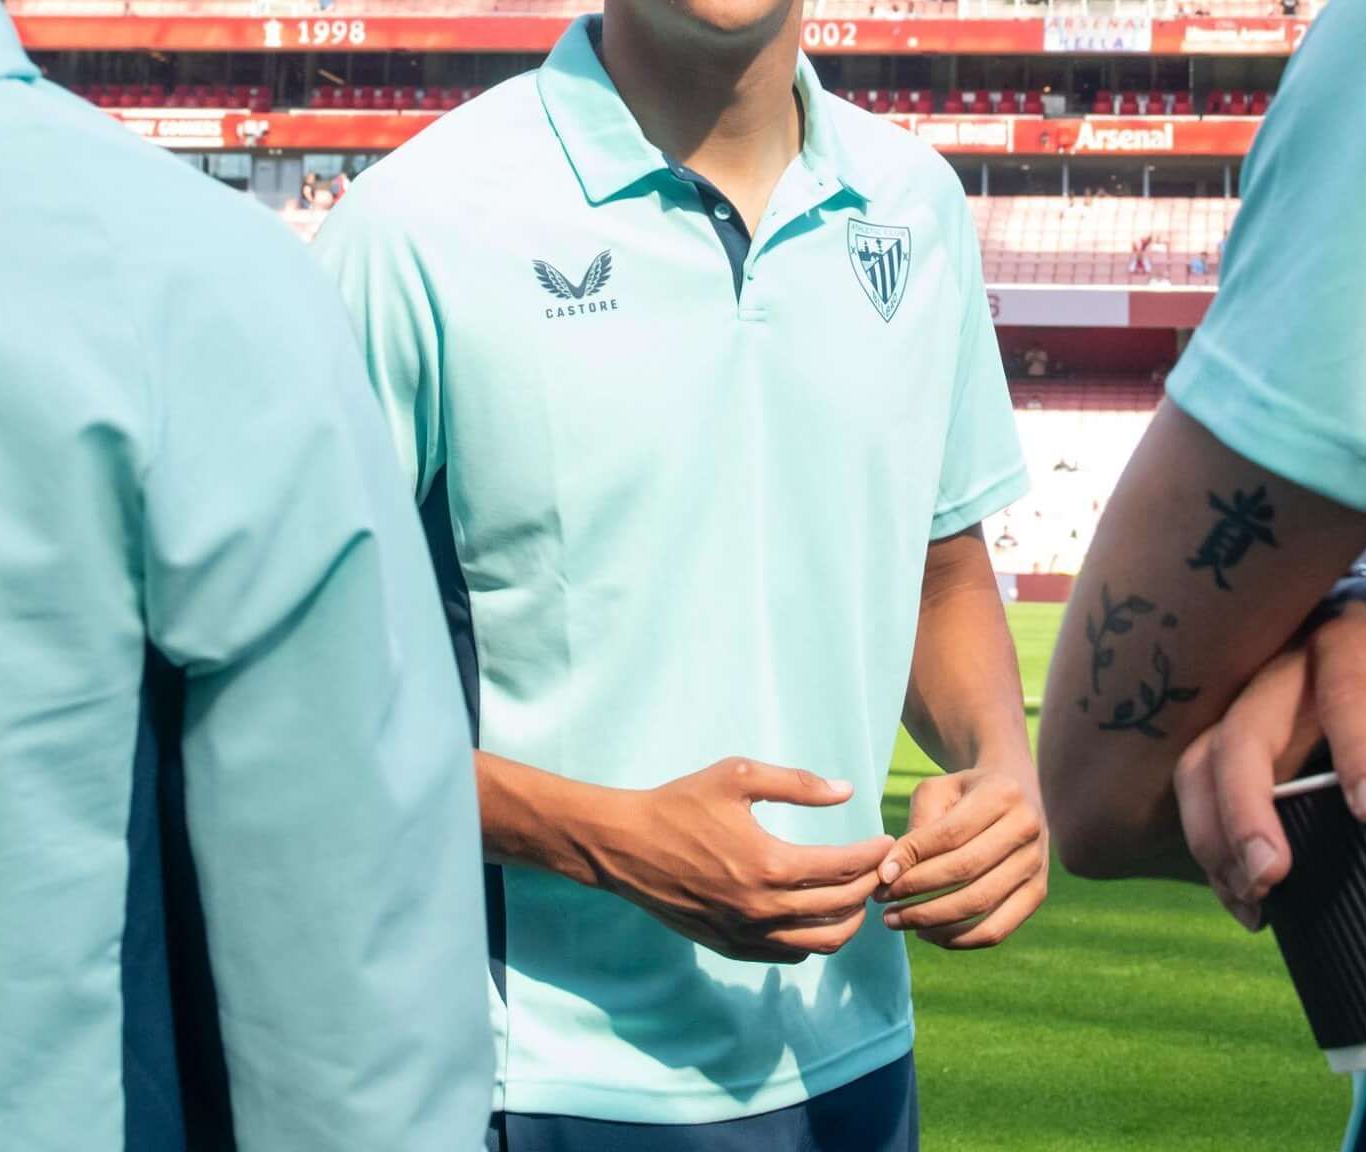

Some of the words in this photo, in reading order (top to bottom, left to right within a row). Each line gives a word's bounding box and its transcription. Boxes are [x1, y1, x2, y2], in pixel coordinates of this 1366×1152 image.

[296, 20, 366, 44] 1998
[803, 22, 857, 47] 002
[1072, 121, 1175, 151] Arsenal
[545, 299, 619, 319] CASTORE
